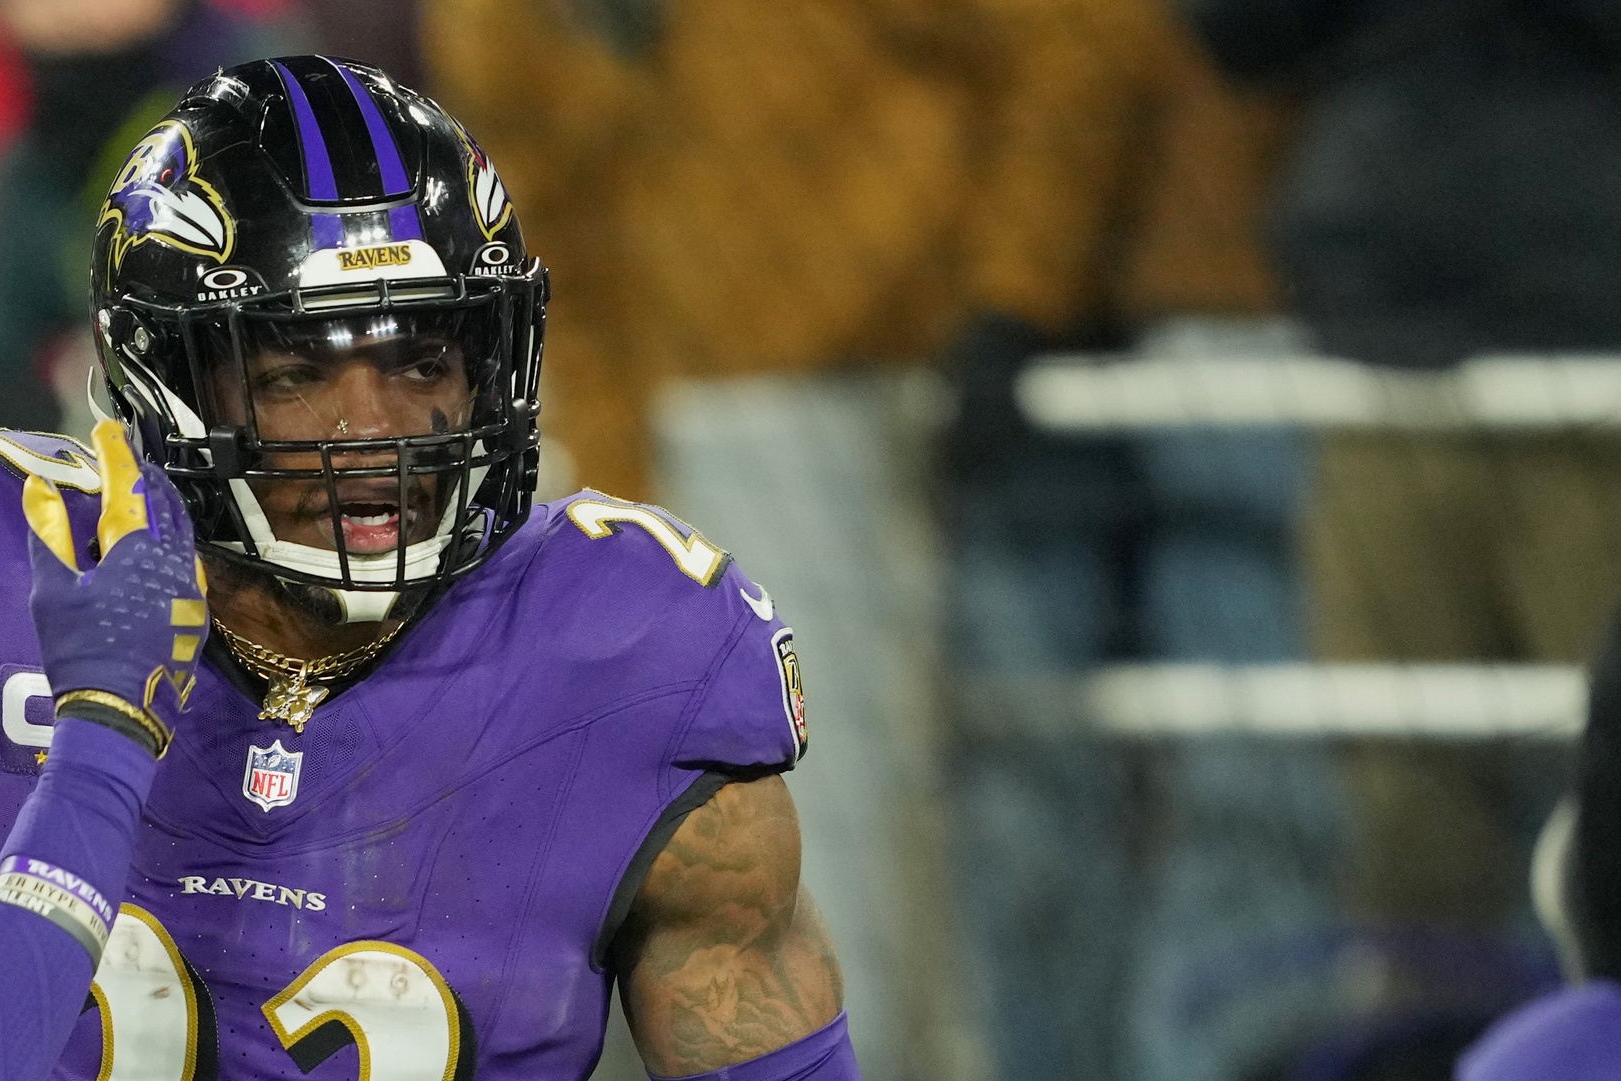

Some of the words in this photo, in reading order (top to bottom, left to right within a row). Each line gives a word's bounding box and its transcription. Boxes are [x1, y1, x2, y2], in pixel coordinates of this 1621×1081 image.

[337, 245, 411, 270] RAVENS
[475, 266, 514, 275] OAKLEY
[197, 285, 260, 302] OAKLEY
[251, 770, 289, 798] NFL
[28, 858, 114, 923] RAVENS
[178, 875, 327, 912] RAVENS
